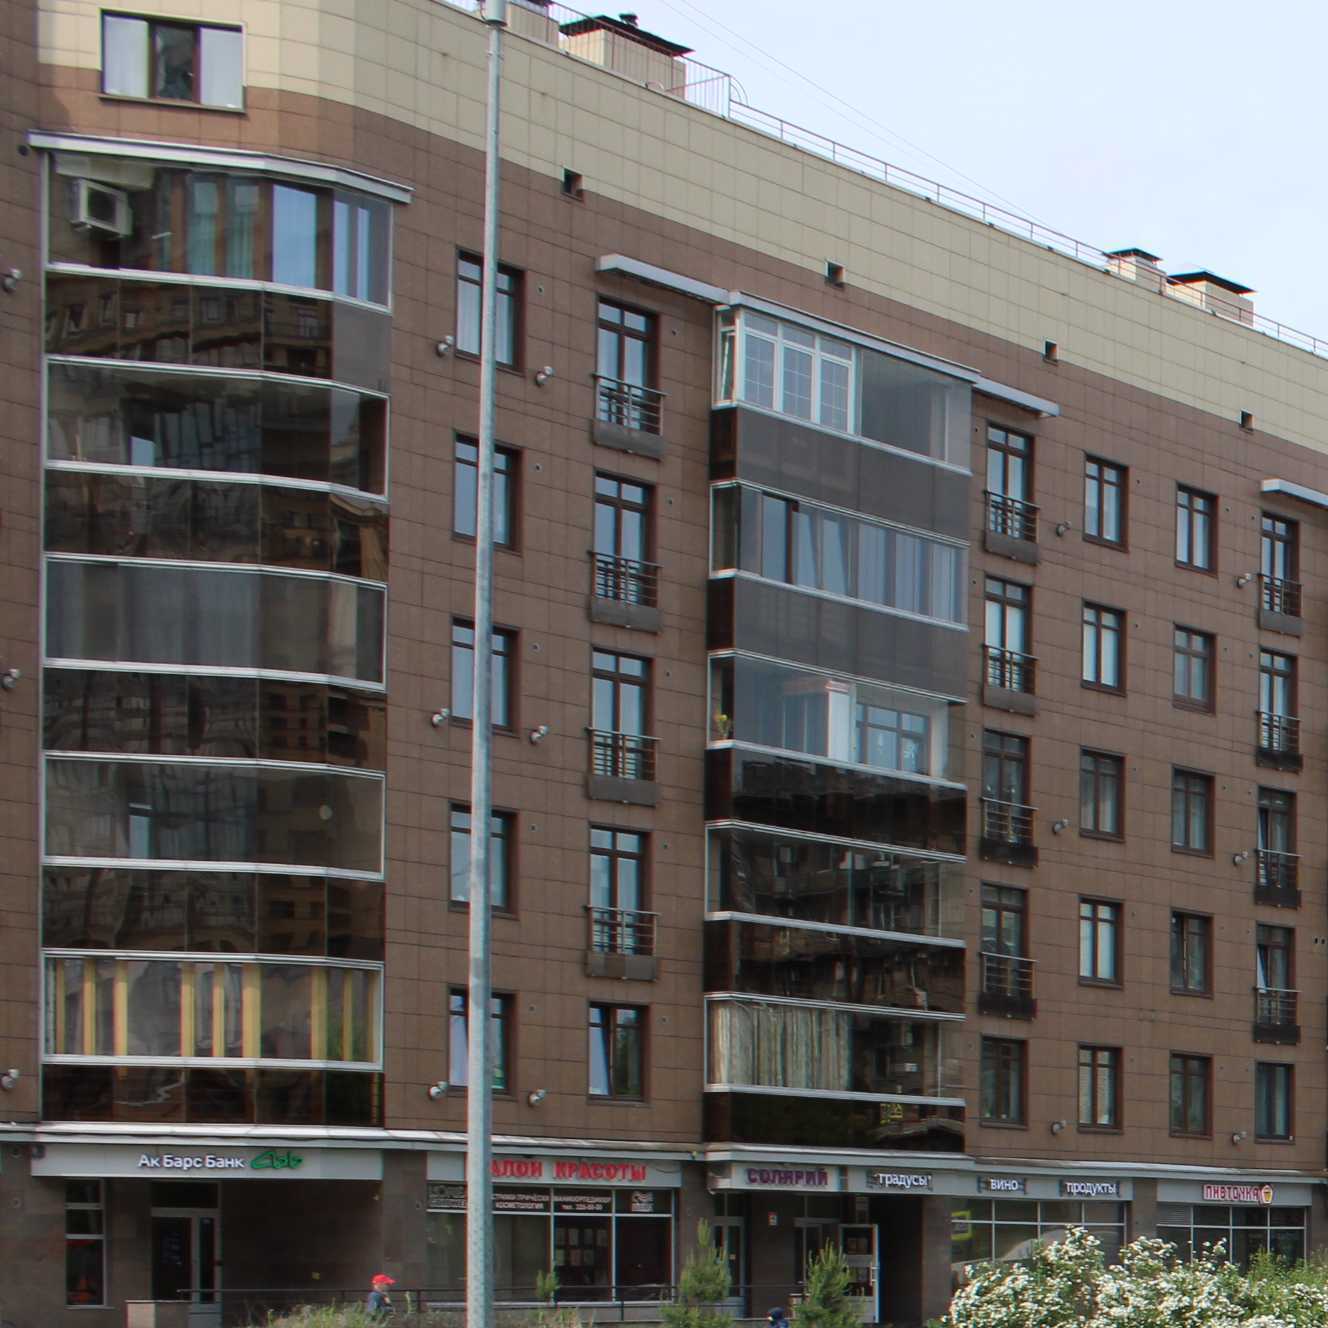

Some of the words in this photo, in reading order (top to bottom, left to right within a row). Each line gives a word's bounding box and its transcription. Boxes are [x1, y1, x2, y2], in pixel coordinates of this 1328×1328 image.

[138, 1154, 160, 1168] Ак
[162, 1155, 203, 1170] Барс
[205, 1155, 245, 1168] Банк
[491, 1159, 543, 1178] АЛОН
[554, 1160, 647, 1181] КРАСОТЫ
[745, 1167, 829, 1186] СОЛЯРИЙ
[1065, 1181, 1117, 1196] продукты
